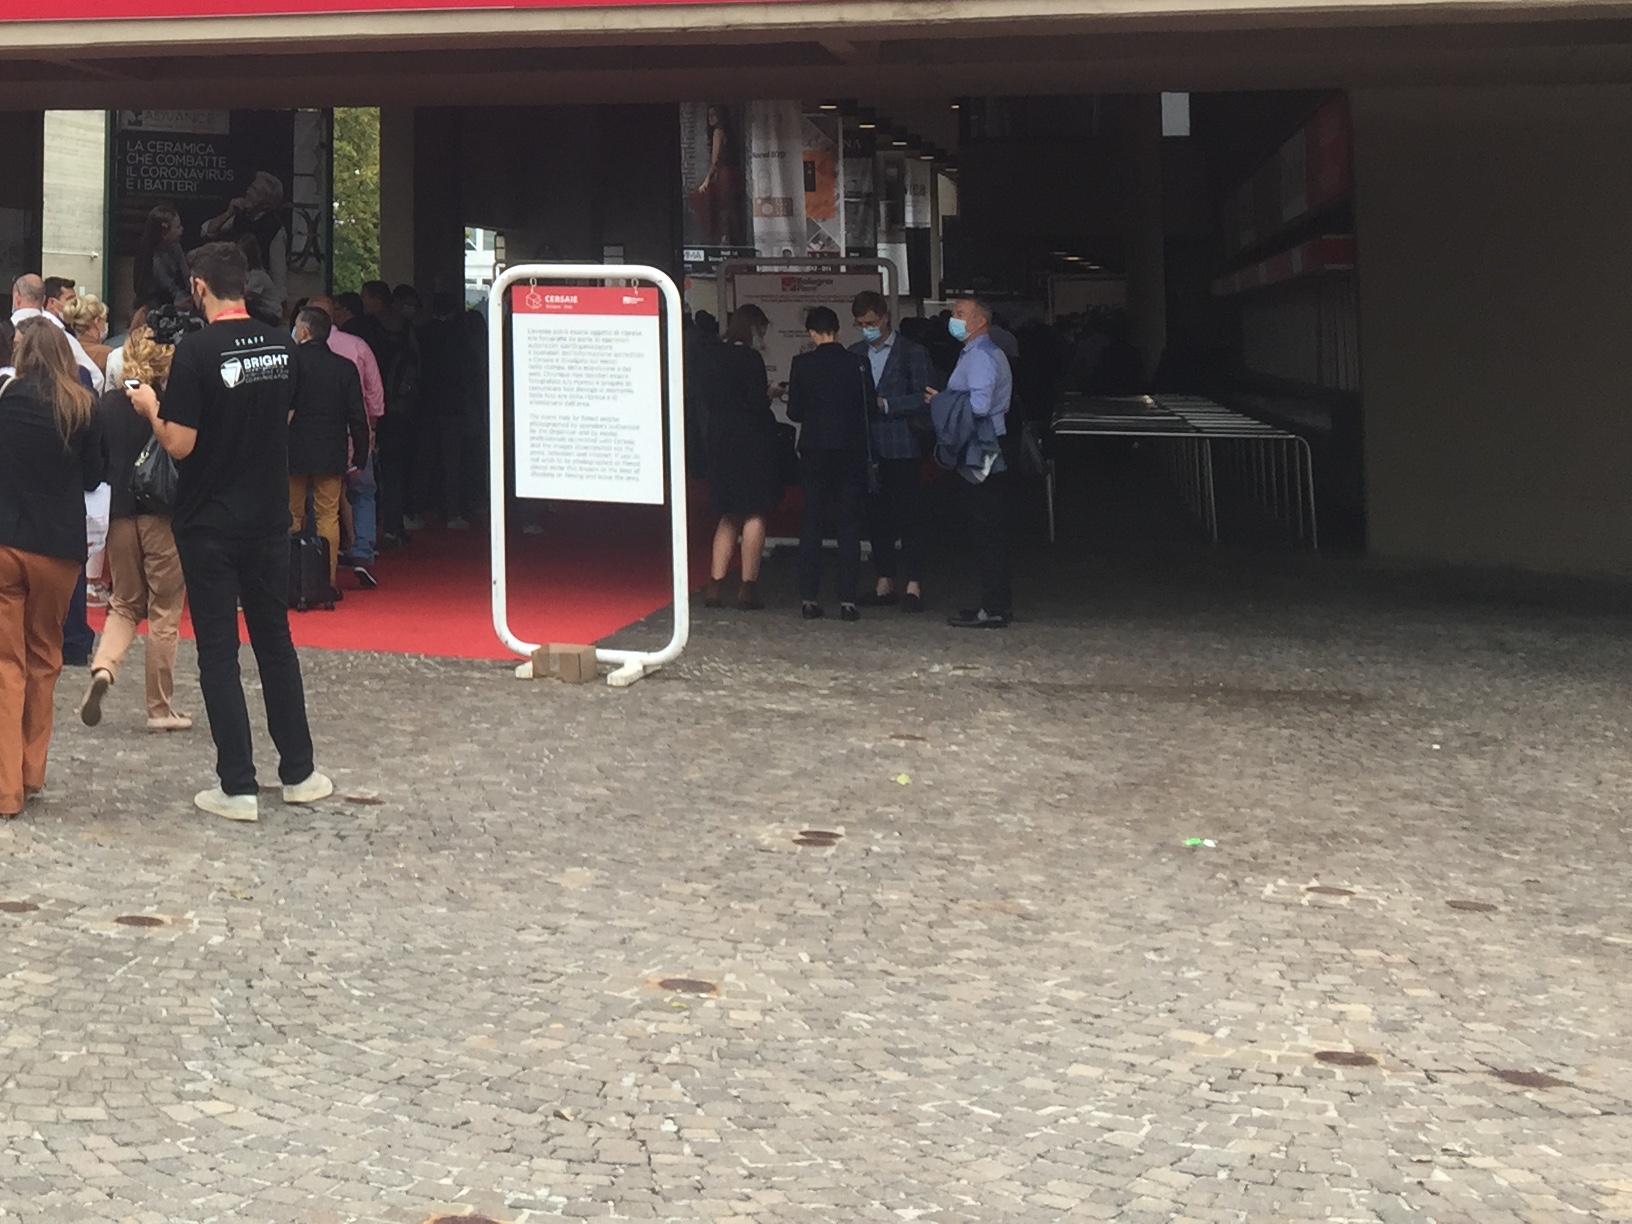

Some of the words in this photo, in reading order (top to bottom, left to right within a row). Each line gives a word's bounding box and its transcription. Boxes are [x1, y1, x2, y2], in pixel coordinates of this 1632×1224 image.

[126, 140, 145, 152] LA
[147, 141, 215, 155] CERAMICA
[125, 153, 153, 165] CHE
[156, 154, 227, 169] COMBATTE
[126, 165, 137, 177] IL
[140, 166, 235, 181] CORONAVIRUS
[126, 178, 135, 190] E
[144, 178, 198, 193] BATTERI
[544, 294, 579, 305] CERSAIE
[234, 335, 265, 347] STAFF
[243, 354, 290, 370] BRIGHT
